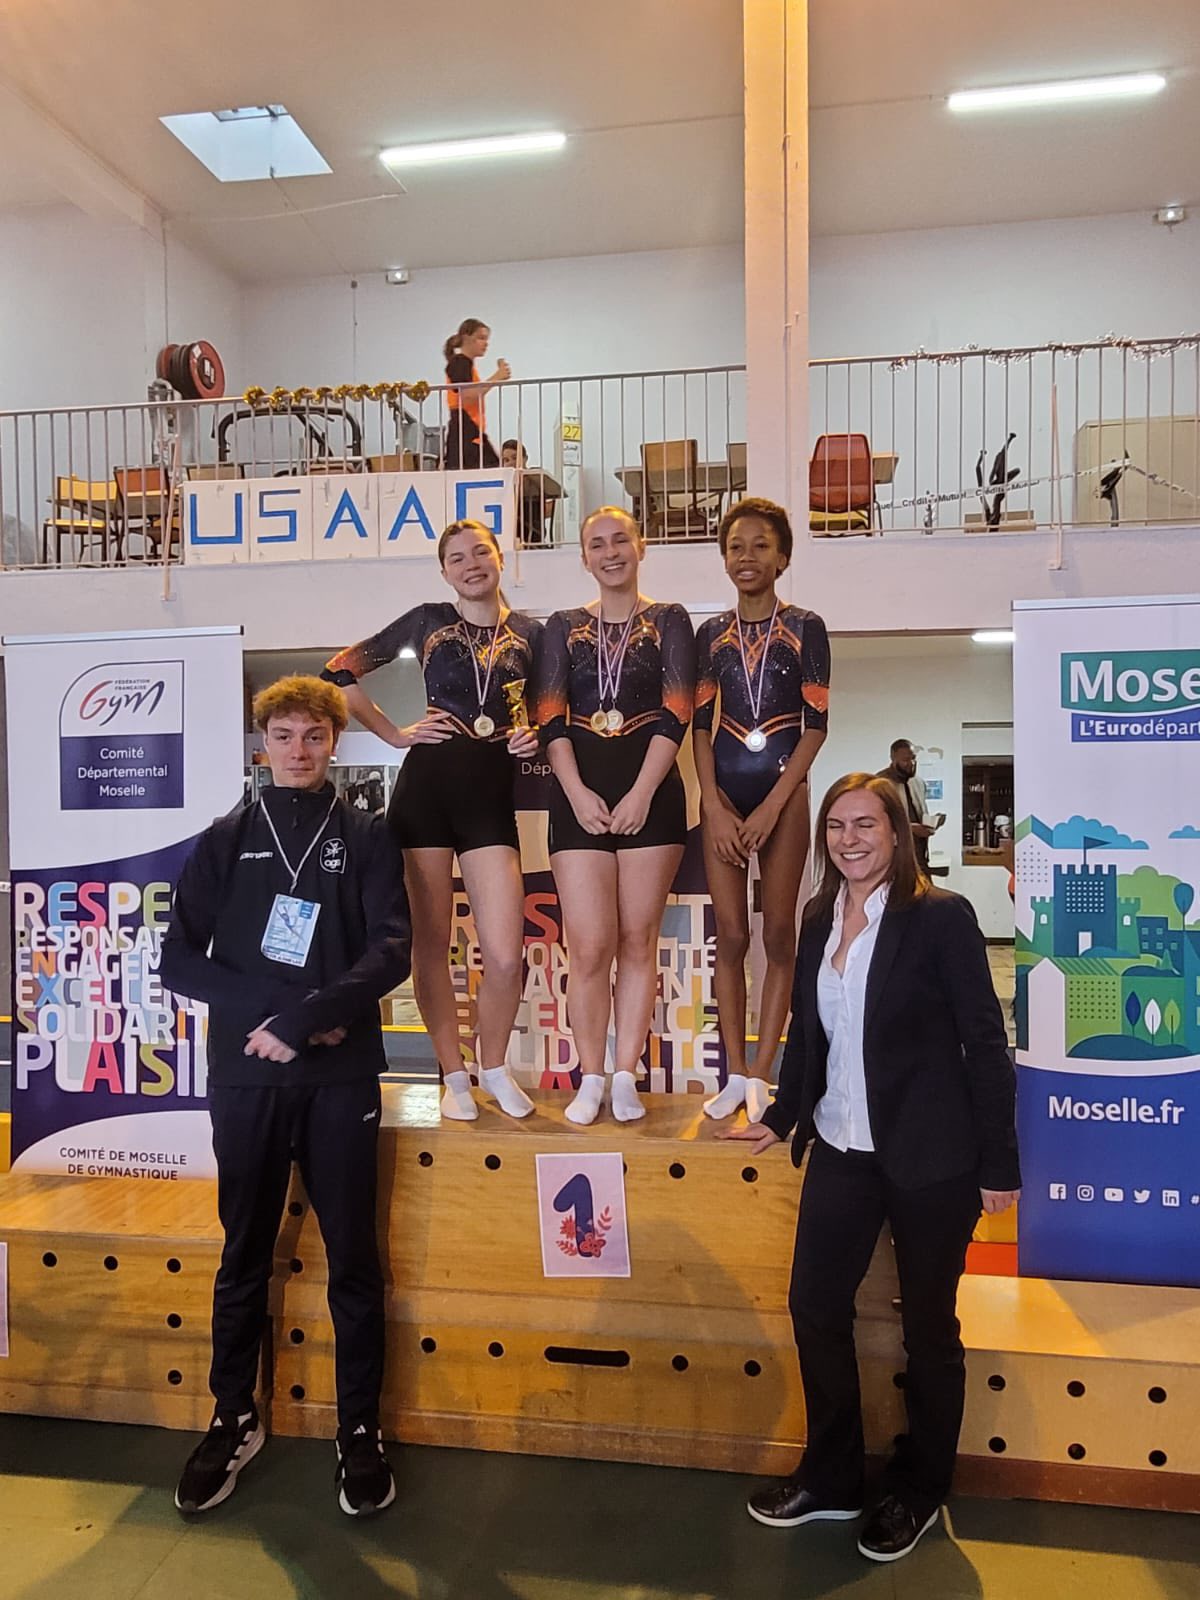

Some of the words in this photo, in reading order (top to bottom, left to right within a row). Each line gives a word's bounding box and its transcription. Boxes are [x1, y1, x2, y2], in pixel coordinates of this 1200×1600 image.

[563, 425, 580, 438] 27
[190, 480, 504, 545] USAAG
[100, 747, 144, 760] Comité
[78, 764, 168, 779] Départemental
[521, 761, 552, 777] Dép
[99, 784, 146, 797] Moselle
[15, 882, 177, 928] RESPE
[1049, 1096, 1185, 1124] Moselle.fr
[59, 1147, 106, 1160] COMITÉ
[109, 1150, 126, 1161] DE
[129, 1152, 188, 1165] MOSELLE
[67, 1163, 84, 1175] DE
[87, 1165, 179, 1181] GYMNASTIQUE
[552, 1173, 596, 1258] 1
